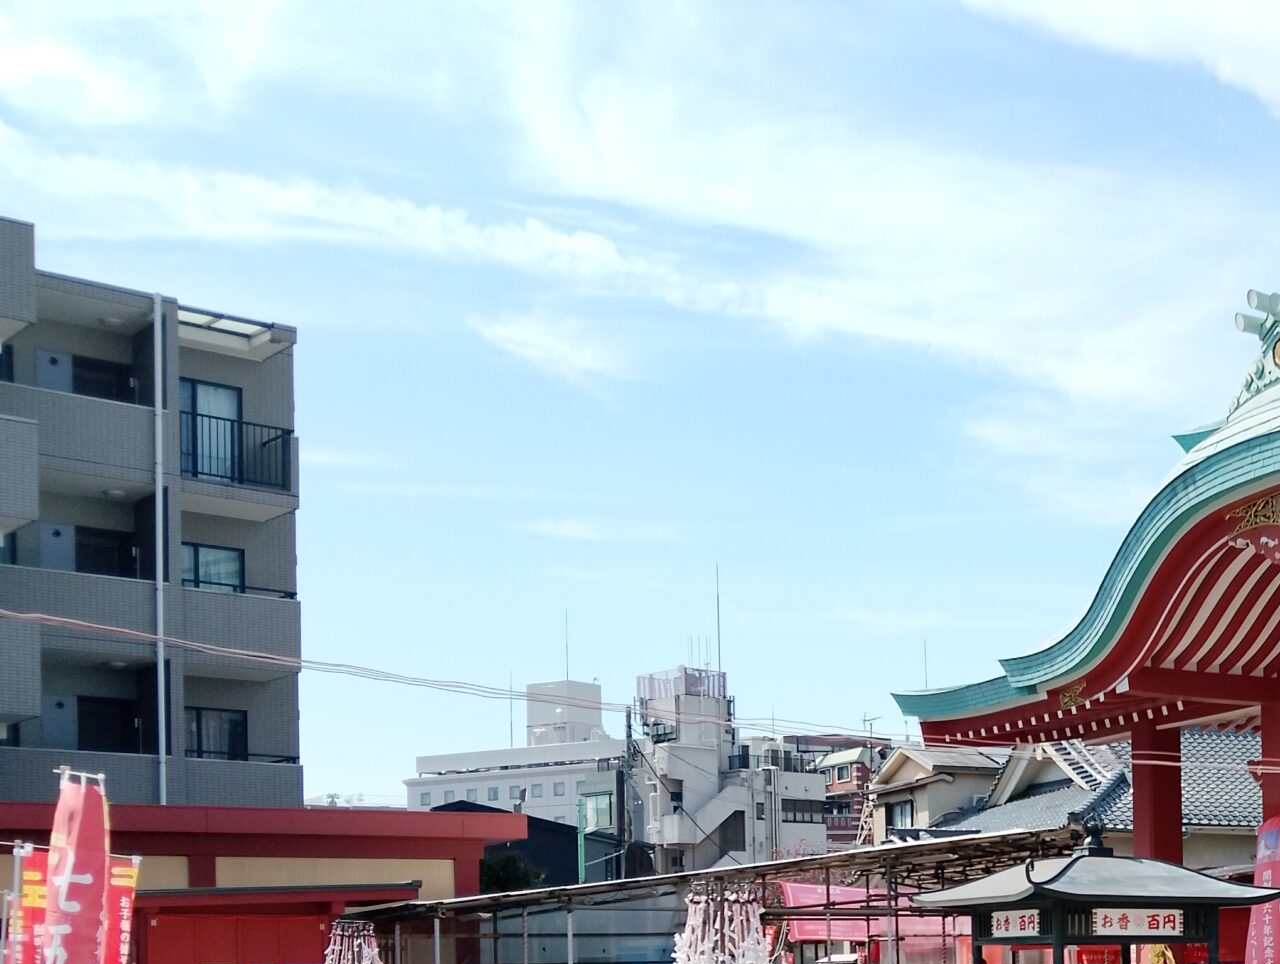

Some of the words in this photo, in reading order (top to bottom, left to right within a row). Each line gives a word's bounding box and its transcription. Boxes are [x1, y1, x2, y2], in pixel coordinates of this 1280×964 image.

[995, 915, 1011, 932] お香
[1018, 913, 1036, 932] 百円
[1101, 913, 1132, 931] お香
[1146, 913, 1177, 931] 百円
